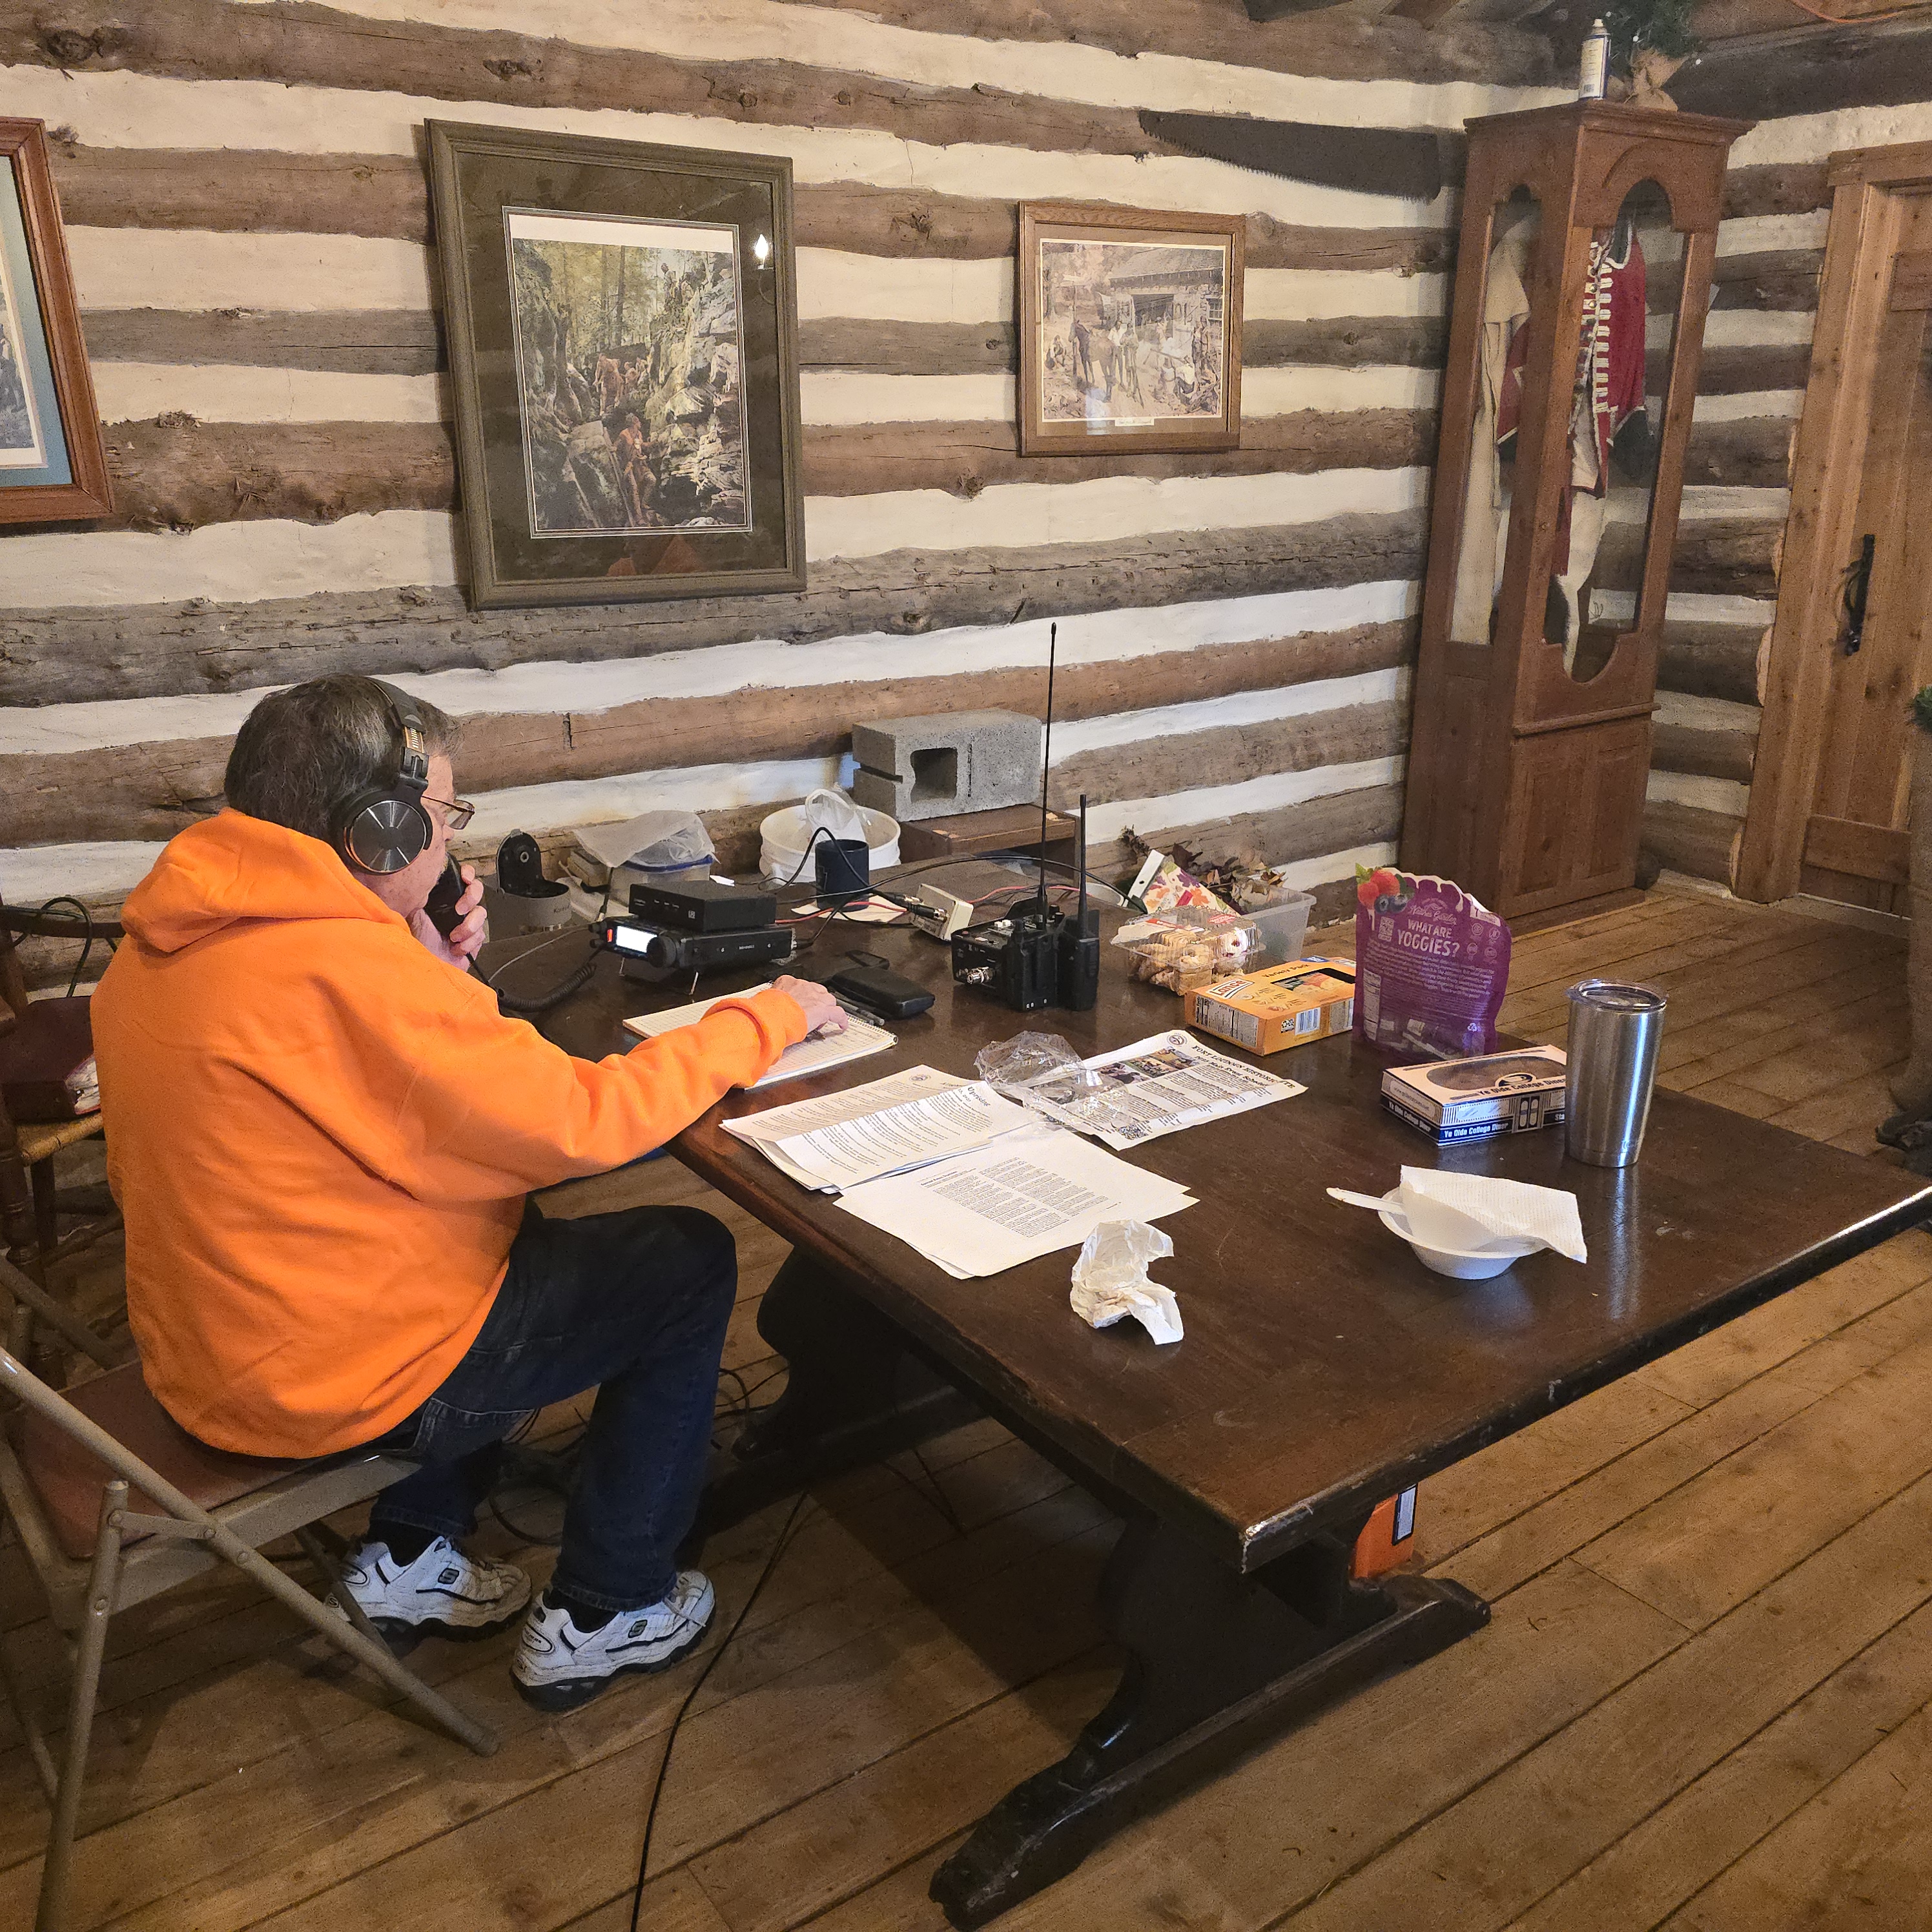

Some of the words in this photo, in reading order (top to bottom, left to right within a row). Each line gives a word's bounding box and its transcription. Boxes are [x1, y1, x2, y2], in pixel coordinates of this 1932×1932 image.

[1408, 919, 1434, 935] WHAT
[1433, 924, 1452, 939] ARE
[1397, 929, 1461, 958] YOGGIES?
[1209, 979, 1248, 996] Lance
[1191, 1045, 1213, 1057] FORT
[1511, 1081, 1545, 1090] College
[1454, 1127, 1468, 1136] Olde
[1468, 1124, 1491, 1135] College
[1492, 1122, 1509, 1131] Diner
